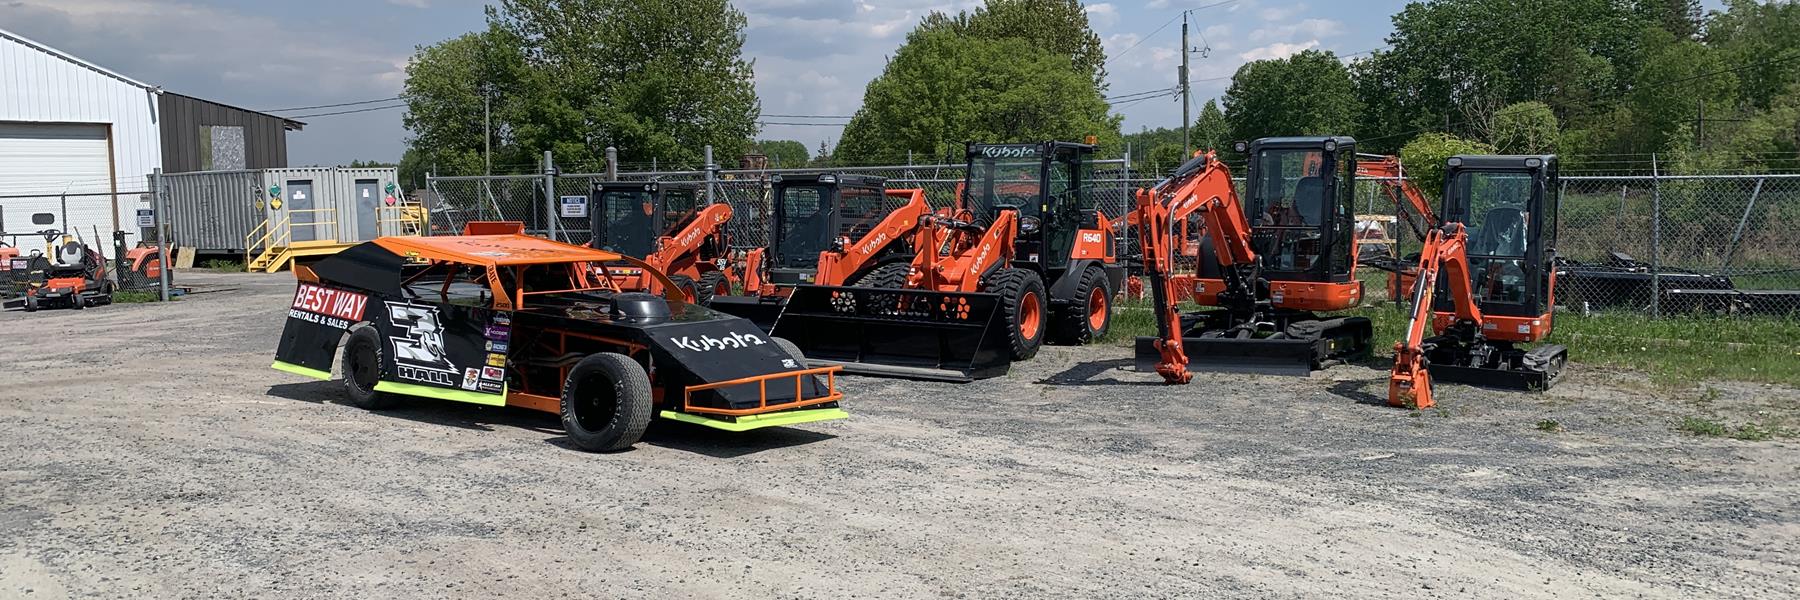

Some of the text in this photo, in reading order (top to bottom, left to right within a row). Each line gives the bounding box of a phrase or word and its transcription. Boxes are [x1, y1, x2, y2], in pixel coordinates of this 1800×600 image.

[982, 146, 1035, 158] Kubota
[681, 227, 701, 247] Kubota
[862, 232, 886, 255] Kubota
[1082, 233, 1101, 243] R640
[970, 243, 990, 276] Kubota
[488, 264, 498, 285] CRATE
[294, 284, 368, 320] BEST WAY
[289, 309, 349, 330] RENTALS & SALES
[397, 365, 454, 386] HALL
